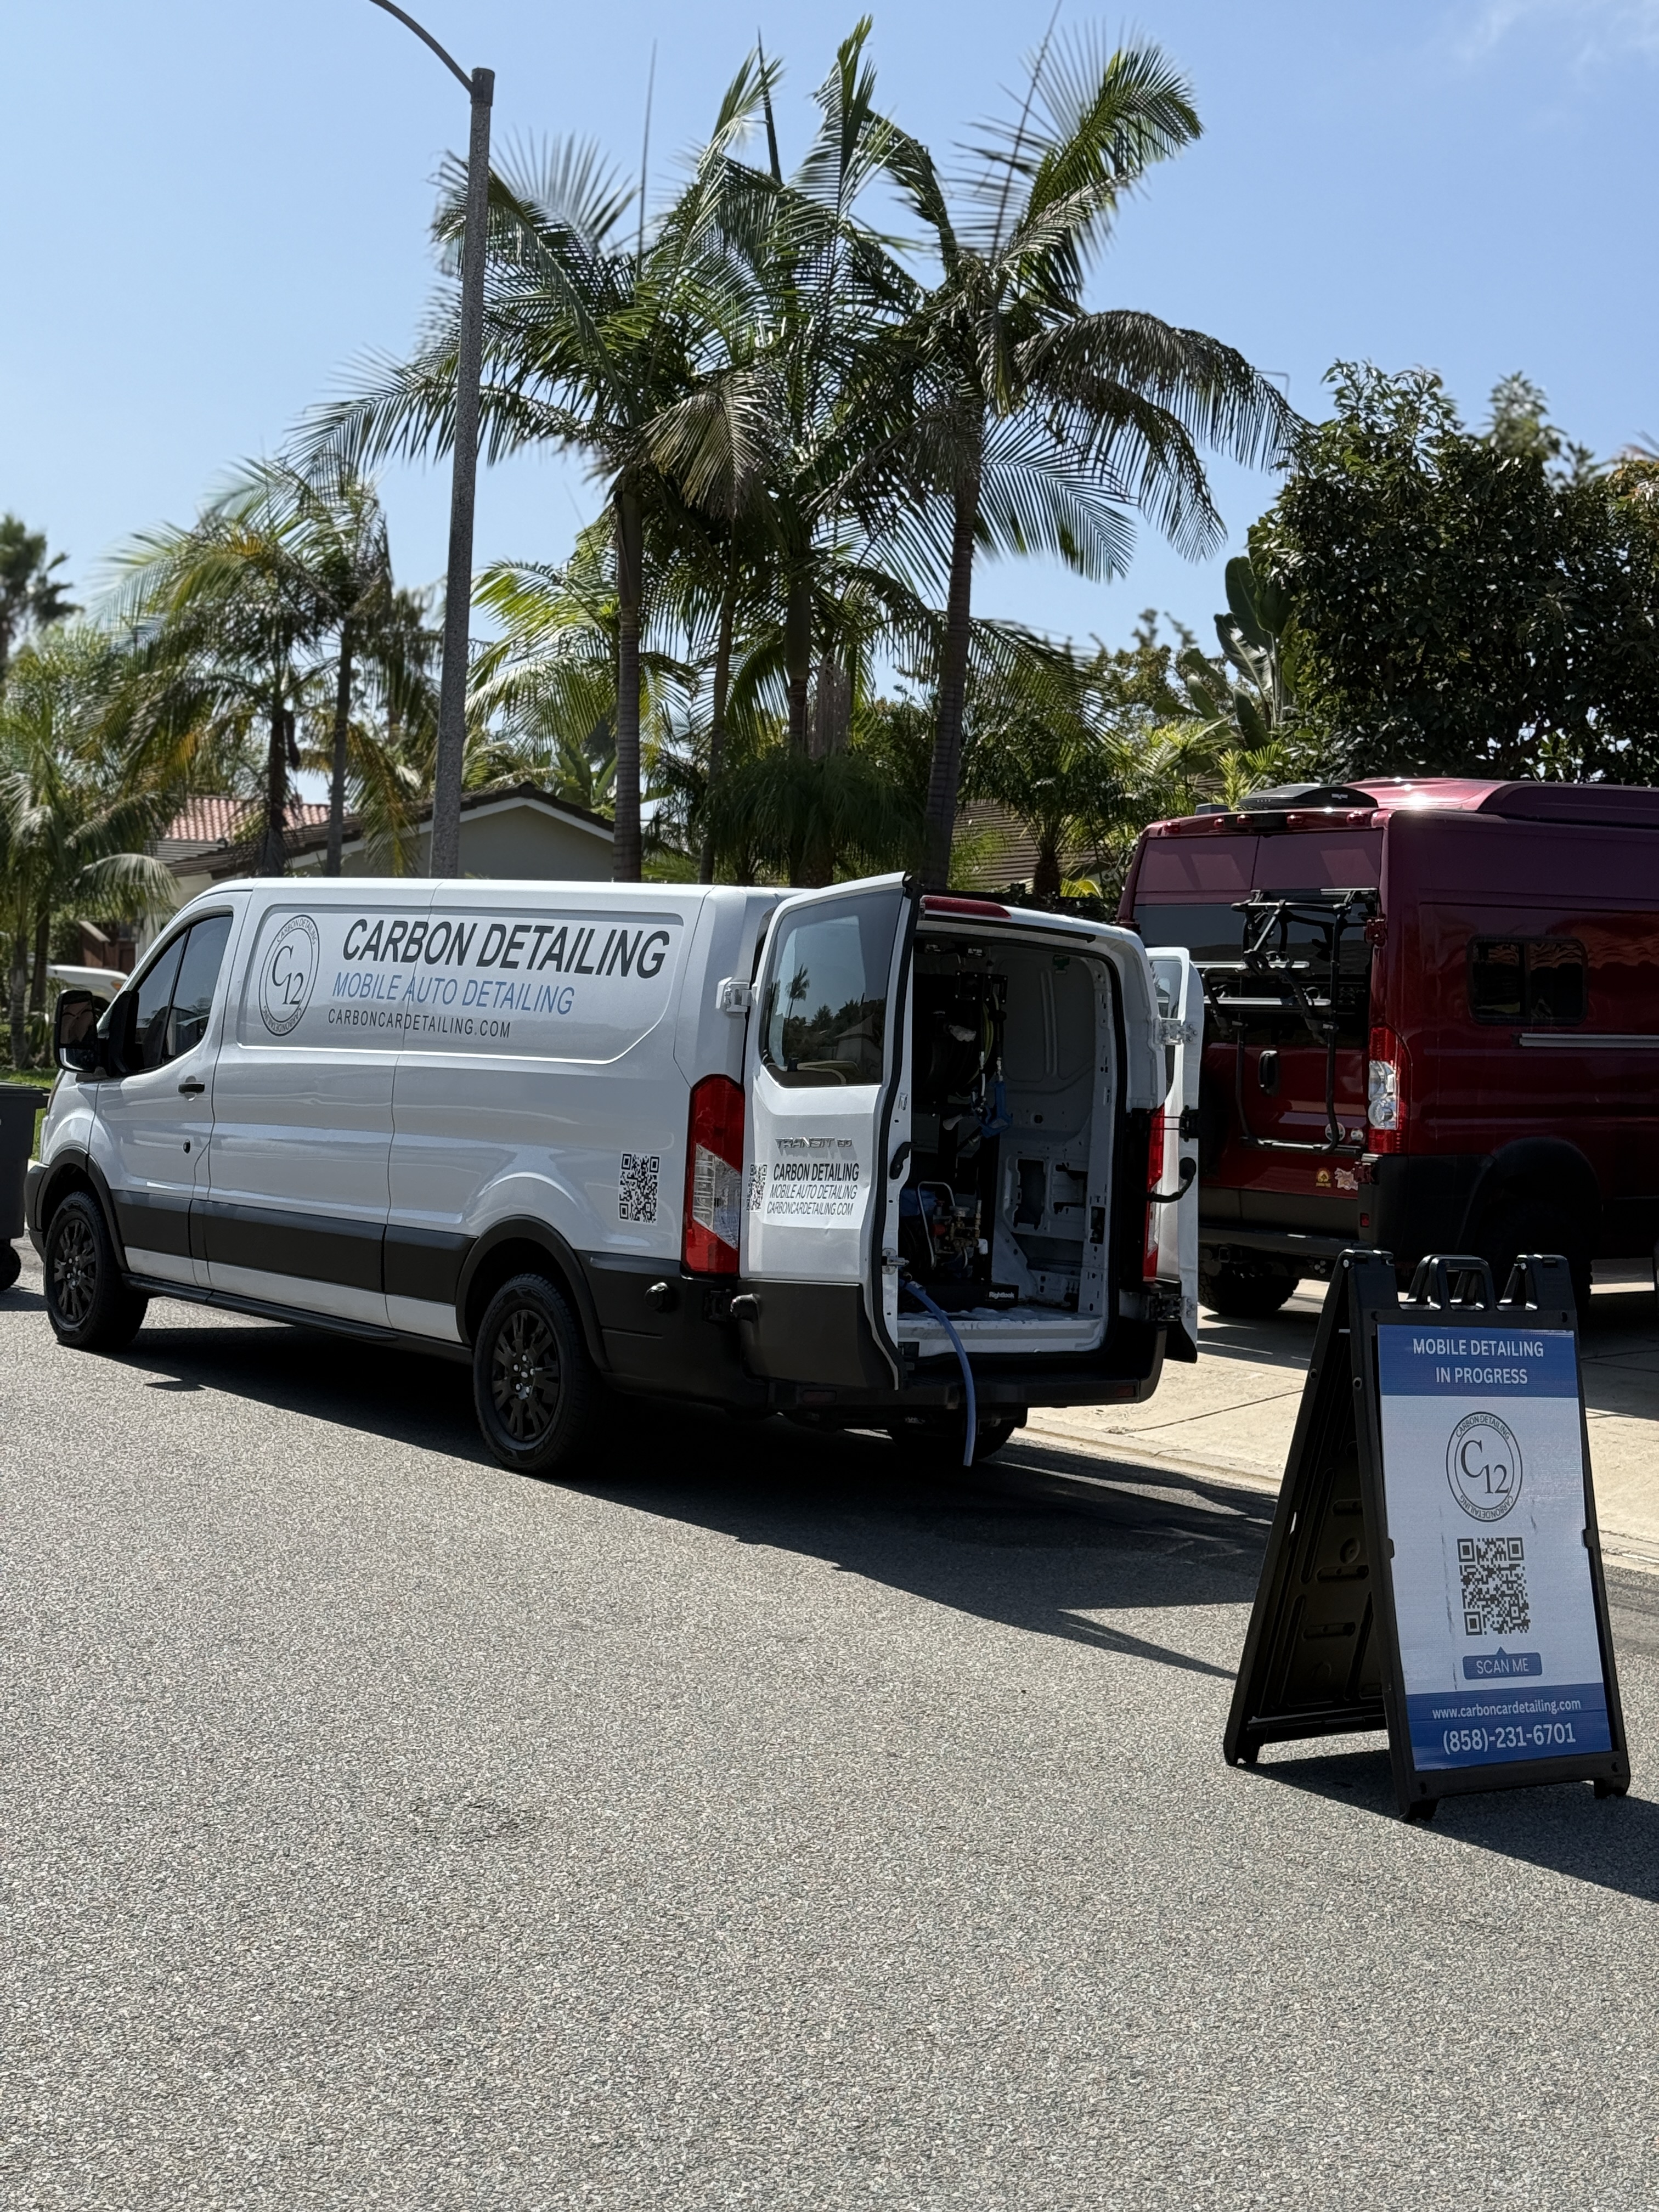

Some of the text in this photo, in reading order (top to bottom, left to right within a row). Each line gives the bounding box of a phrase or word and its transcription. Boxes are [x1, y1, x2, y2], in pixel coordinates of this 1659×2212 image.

[343, 918, 670, 978] CARBON DETAILING
[332, 972, 575, 1015] MOBILE AUTO DETAILING
[328, 1008, 511, 1039] CARBONCARDETAILING.COM
[775, 1137, 835, 1148] TRANSIT
[774, 1163, 860, 1181] CARBON DETAILING
[770, 1184, 857, 1199] MOBILE AUTO DETAILING
[767, 1202, 854, 1215] CARBONCARDETAILING.COM
[1413, 1339, 1544, 1357] MOBILE DETAILING
[1435, 1367, 1527, 1384] IN PROGRESS
[1476, 1657, 1529, 1675] SCAN ME
[1432, 1699, 1581, 1720] www.carboncardetailing.com
[1442, 1722, 1576, 1755] (858)-231-6701
